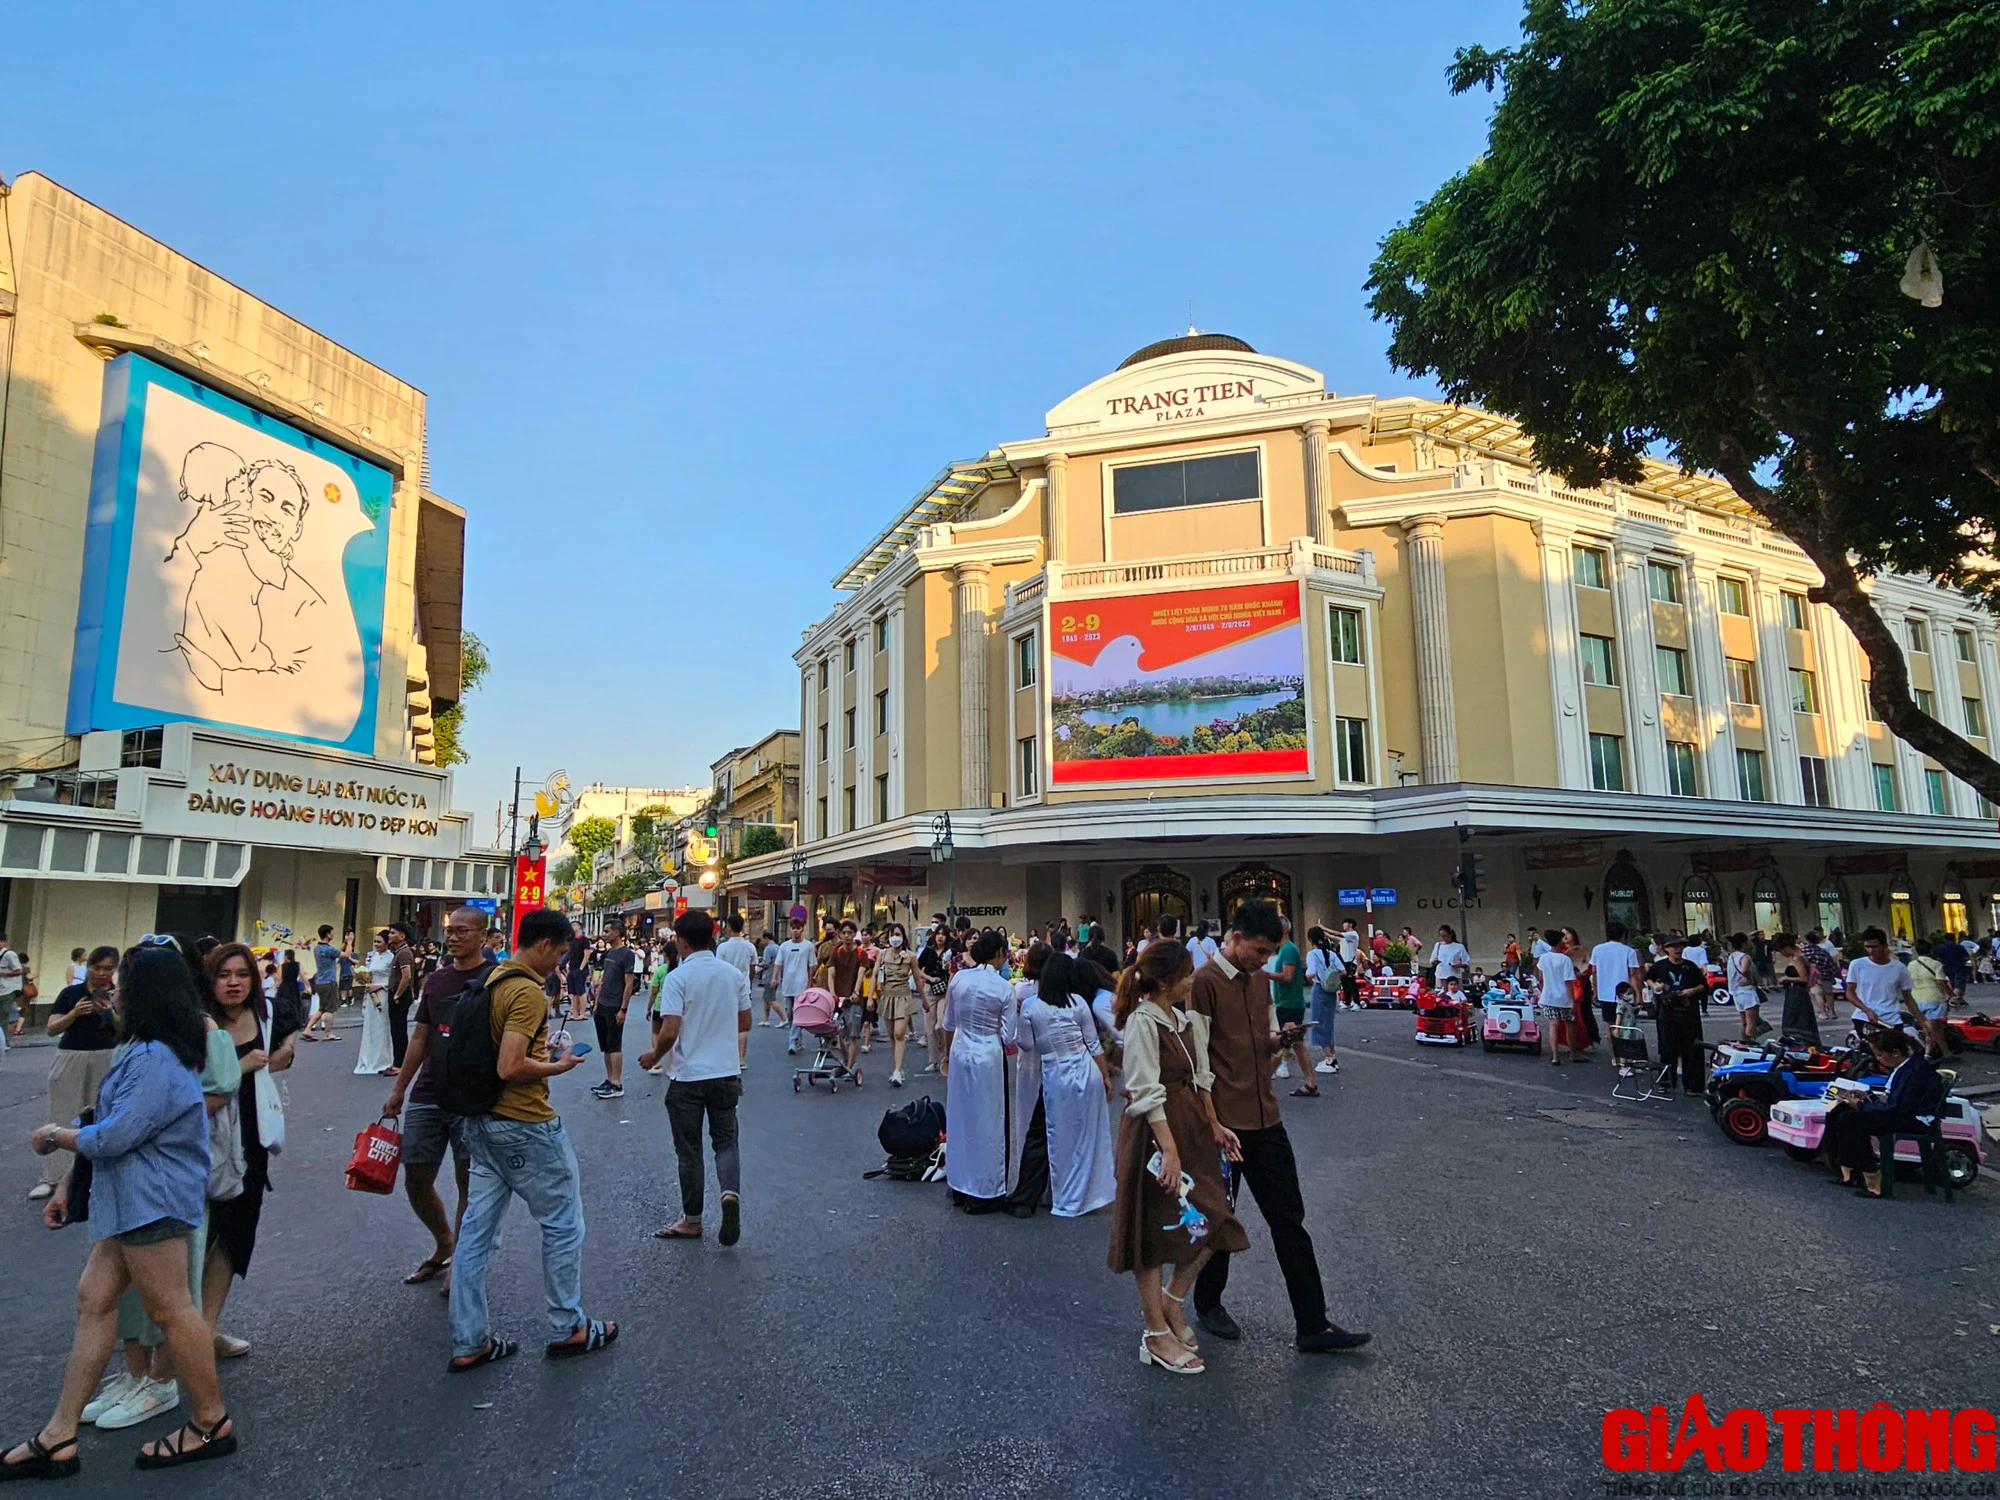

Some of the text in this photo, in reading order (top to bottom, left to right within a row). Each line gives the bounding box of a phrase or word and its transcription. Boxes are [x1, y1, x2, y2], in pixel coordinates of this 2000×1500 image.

[1106, 379, 1255, 416] TRANG TIEN
[1156, 407, 1205, 421] PLAZA
[1061, 614, 1100, 633] 2-9
[1062, 634, 1078, 643] 1945
[1084, 632, 1101, 641] 2023
[208, 762, 427, 809] XÂY DỤNG LẠI ĐẤT NƯỚC TA
[188, 788, 438, 836] ĐÀNG HOÀNG HƠN TO ĐẸP HƠN
[1610, 890, 1634, 898] HUBLOT
[1756, 891, 1777, 899] GUCCI
[1416, 897, 1482, 909] GUCCI
[367, 1147, 393, 1165] CITY
